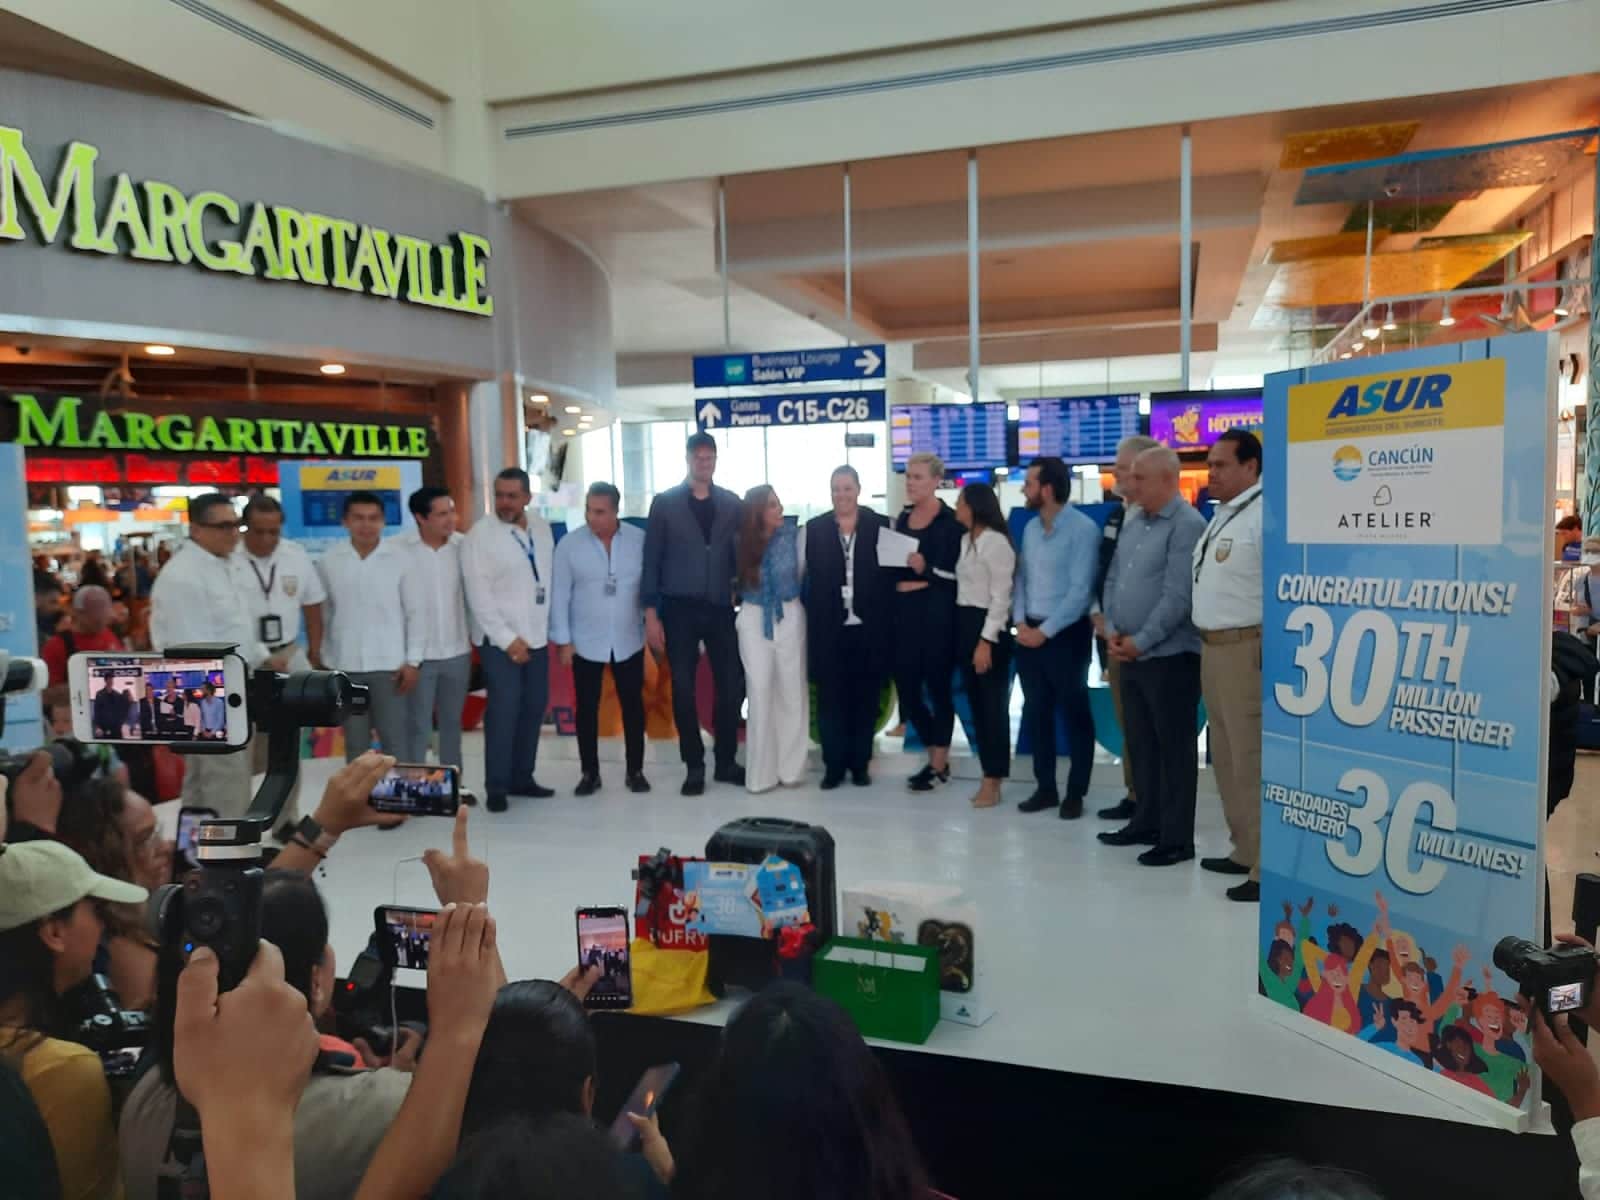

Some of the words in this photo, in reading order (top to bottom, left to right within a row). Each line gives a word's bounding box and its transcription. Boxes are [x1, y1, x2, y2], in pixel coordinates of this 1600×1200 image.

[0, 125, 493, 316] MARGARITAVILLE
[785, 366, 806, 379] VIP
[777, 398, 869, 423] C15-C26
[1327, 373, 1452, 419] ASUR
[12, 395, 429, 457] MARGARITAVILLE
[731, 413, 772, 425] Puertas
[1368, 444, 1433, 466] CANCÚN
[327, 469, 377, 481] ASUR
[1338, 512, 1432, 528] ATELIER
[1278, 574, 1517, 615] CONGRATULATIONS!
[1394, 683, 1481, 716] MILLION
[1390, 707, 1516, 748] PASSENGER
[1266, 784, 1349, 820] ¡FELICIDADES
[1282, 805, 1347, 838] PASAJERO
[1417, 831, 1528, 878] MILLONES!
